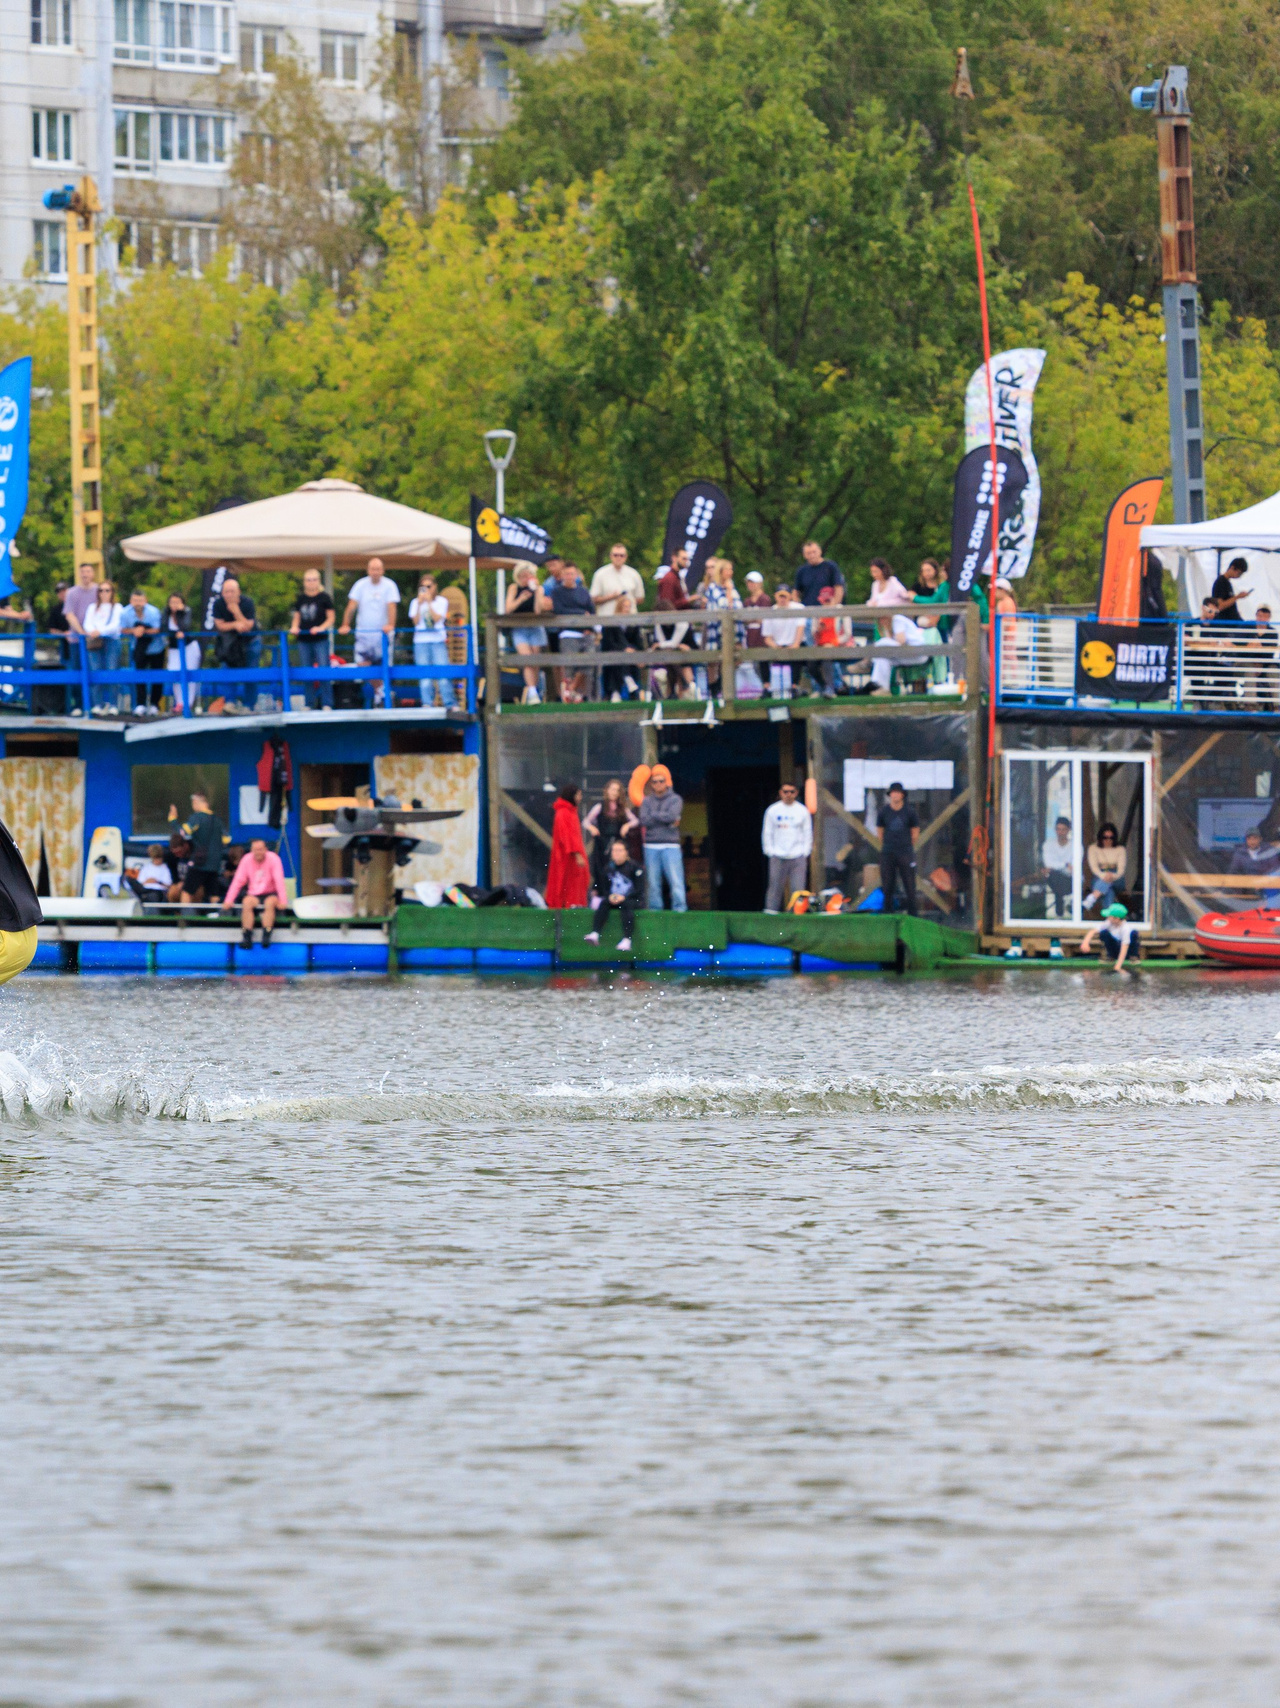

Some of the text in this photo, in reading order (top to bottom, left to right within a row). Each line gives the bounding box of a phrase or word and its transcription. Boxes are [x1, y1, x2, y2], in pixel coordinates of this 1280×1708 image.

[958, 509, 990, 592] COOL ZONE
[1117, 643, 1169, 665] DIRTY
[1115, 664, 1167, 683] HABITS
